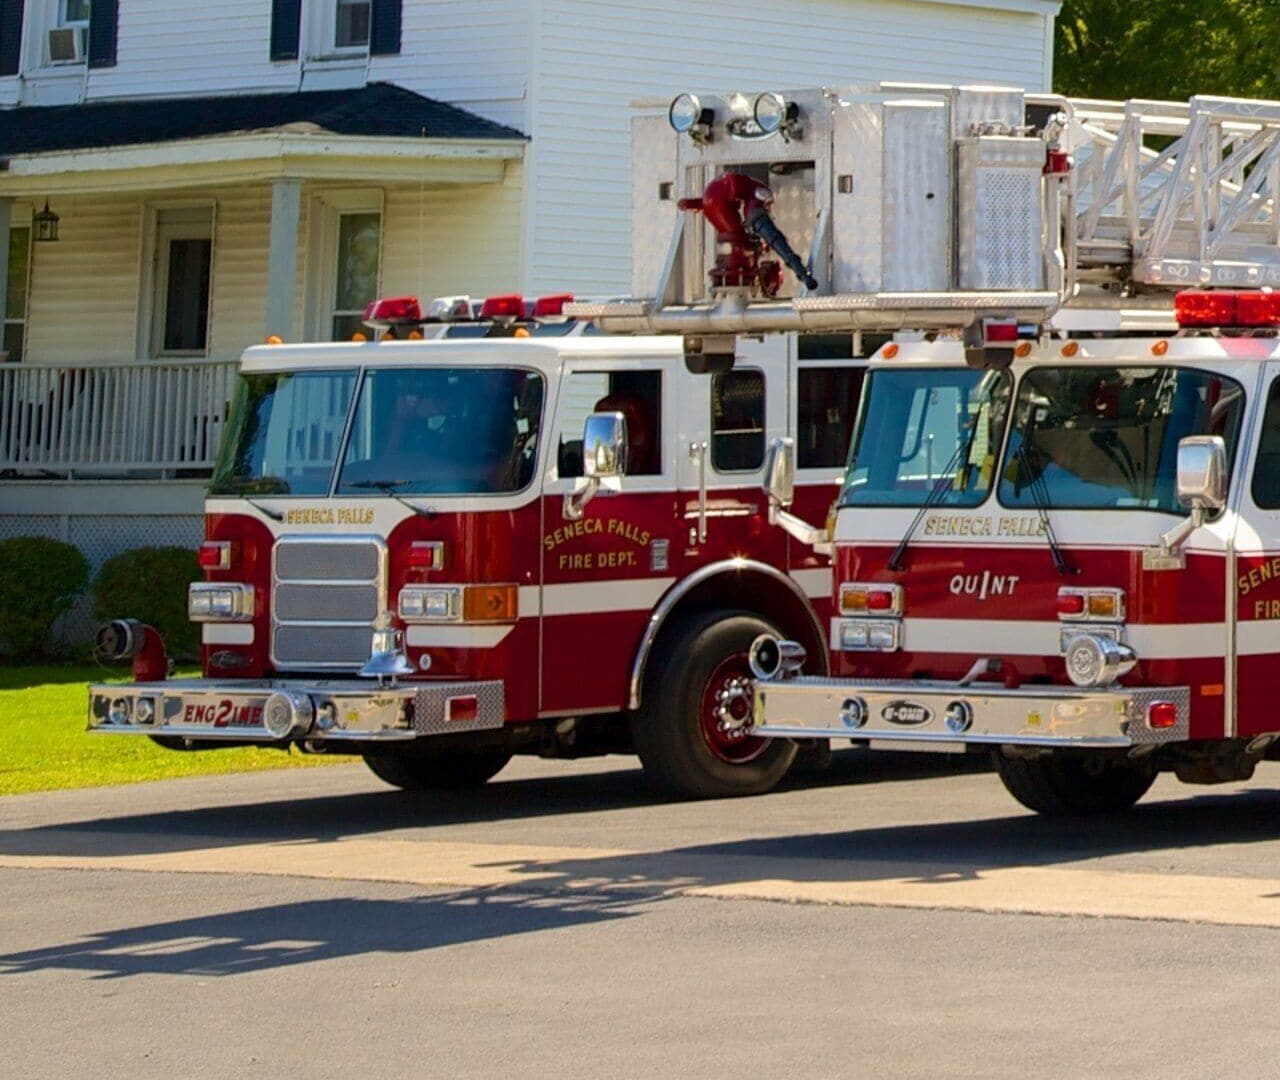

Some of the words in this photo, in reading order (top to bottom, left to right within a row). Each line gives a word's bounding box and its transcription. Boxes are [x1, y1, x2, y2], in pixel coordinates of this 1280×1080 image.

[287, 507, 335, 525] SENECA
[338, 506, 374, 525] FALLS
[544, 518, 603, 551] SENECA
[607, 519, 651, 547] FALLS
[924, 516, 993, 537] SENECA
[996, 517, 1049, 537] FALLS
[559, 554, 593, 569] FIRE
[597, 551, 637, 568] DEPT.
